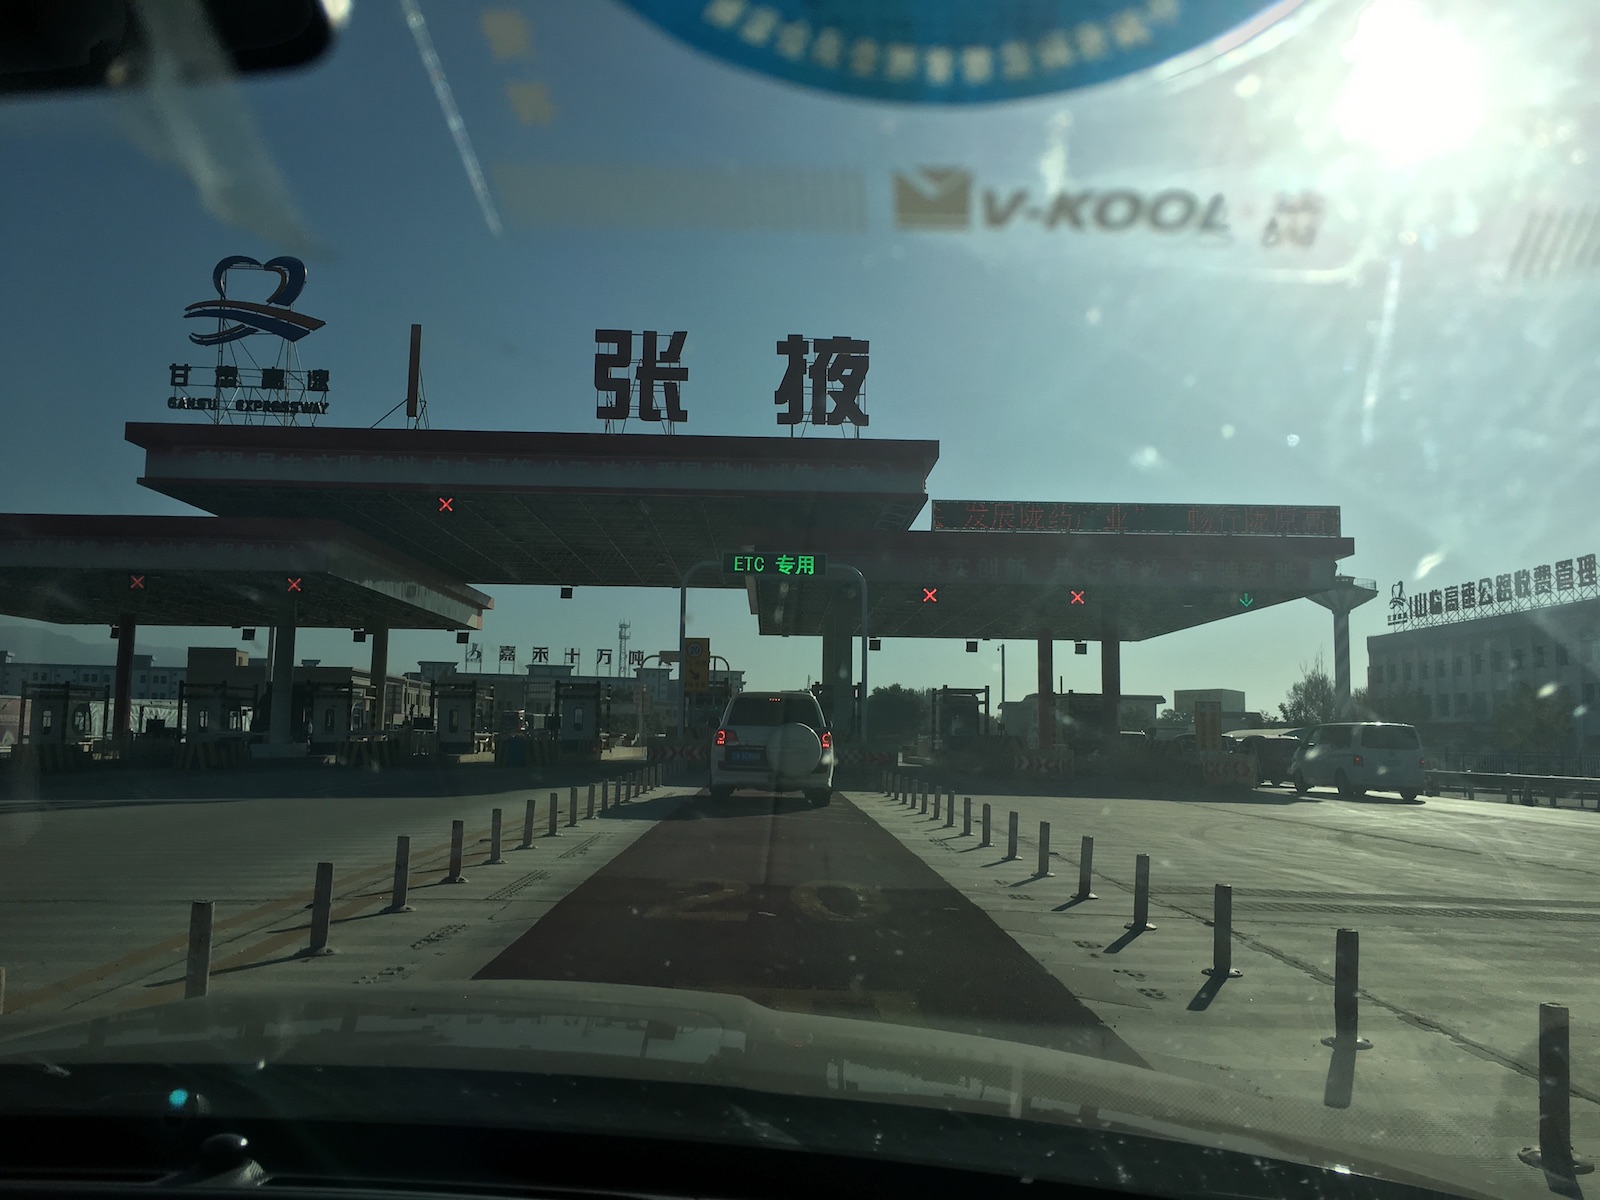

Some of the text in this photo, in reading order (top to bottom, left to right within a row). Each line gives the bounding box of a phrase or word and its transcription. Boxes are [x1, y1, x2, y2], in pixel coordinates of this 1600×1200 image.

[982, 187, 1230, 231] V-KOOL
[594, 329, 870, 427] 张掖
[168, 396, 330, 414] GANSU EXPRESSWAY
[734, 554, 815, 575] ETC 专用
[689, 645, 700, 655] 20
[642, 878, 890, 922] 20
